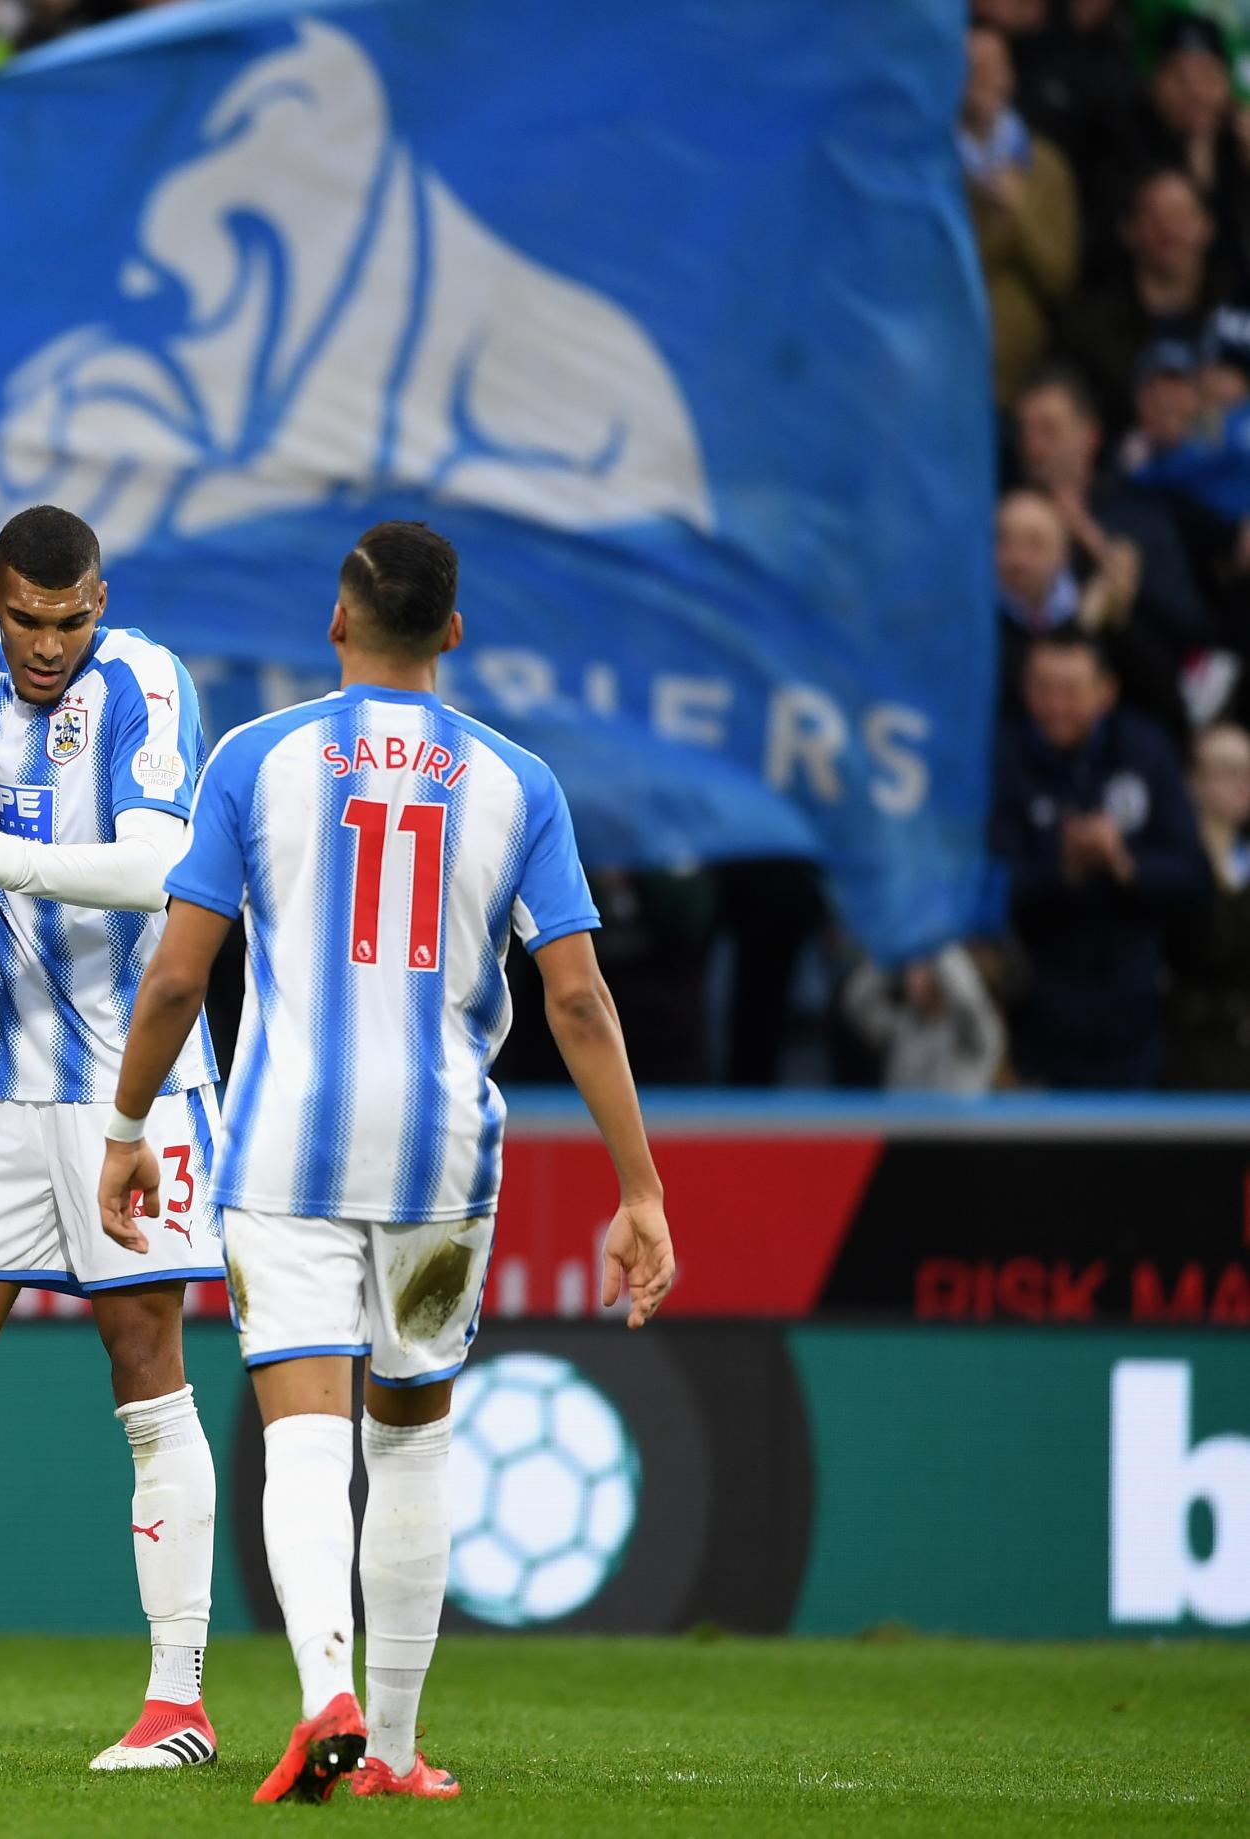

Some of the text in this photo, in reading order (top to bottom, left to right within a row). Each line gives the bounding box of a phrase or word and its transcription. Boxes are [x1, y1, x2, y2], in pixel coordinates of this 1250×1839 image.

[138, 751, 180, 772] PURE
[187, 649, 932, 817] TRIERS
[323, 737, 467, 787] SABIRI
[344, 798, 445, 968] 11
[1108, 1358, 1250, 1628] b
